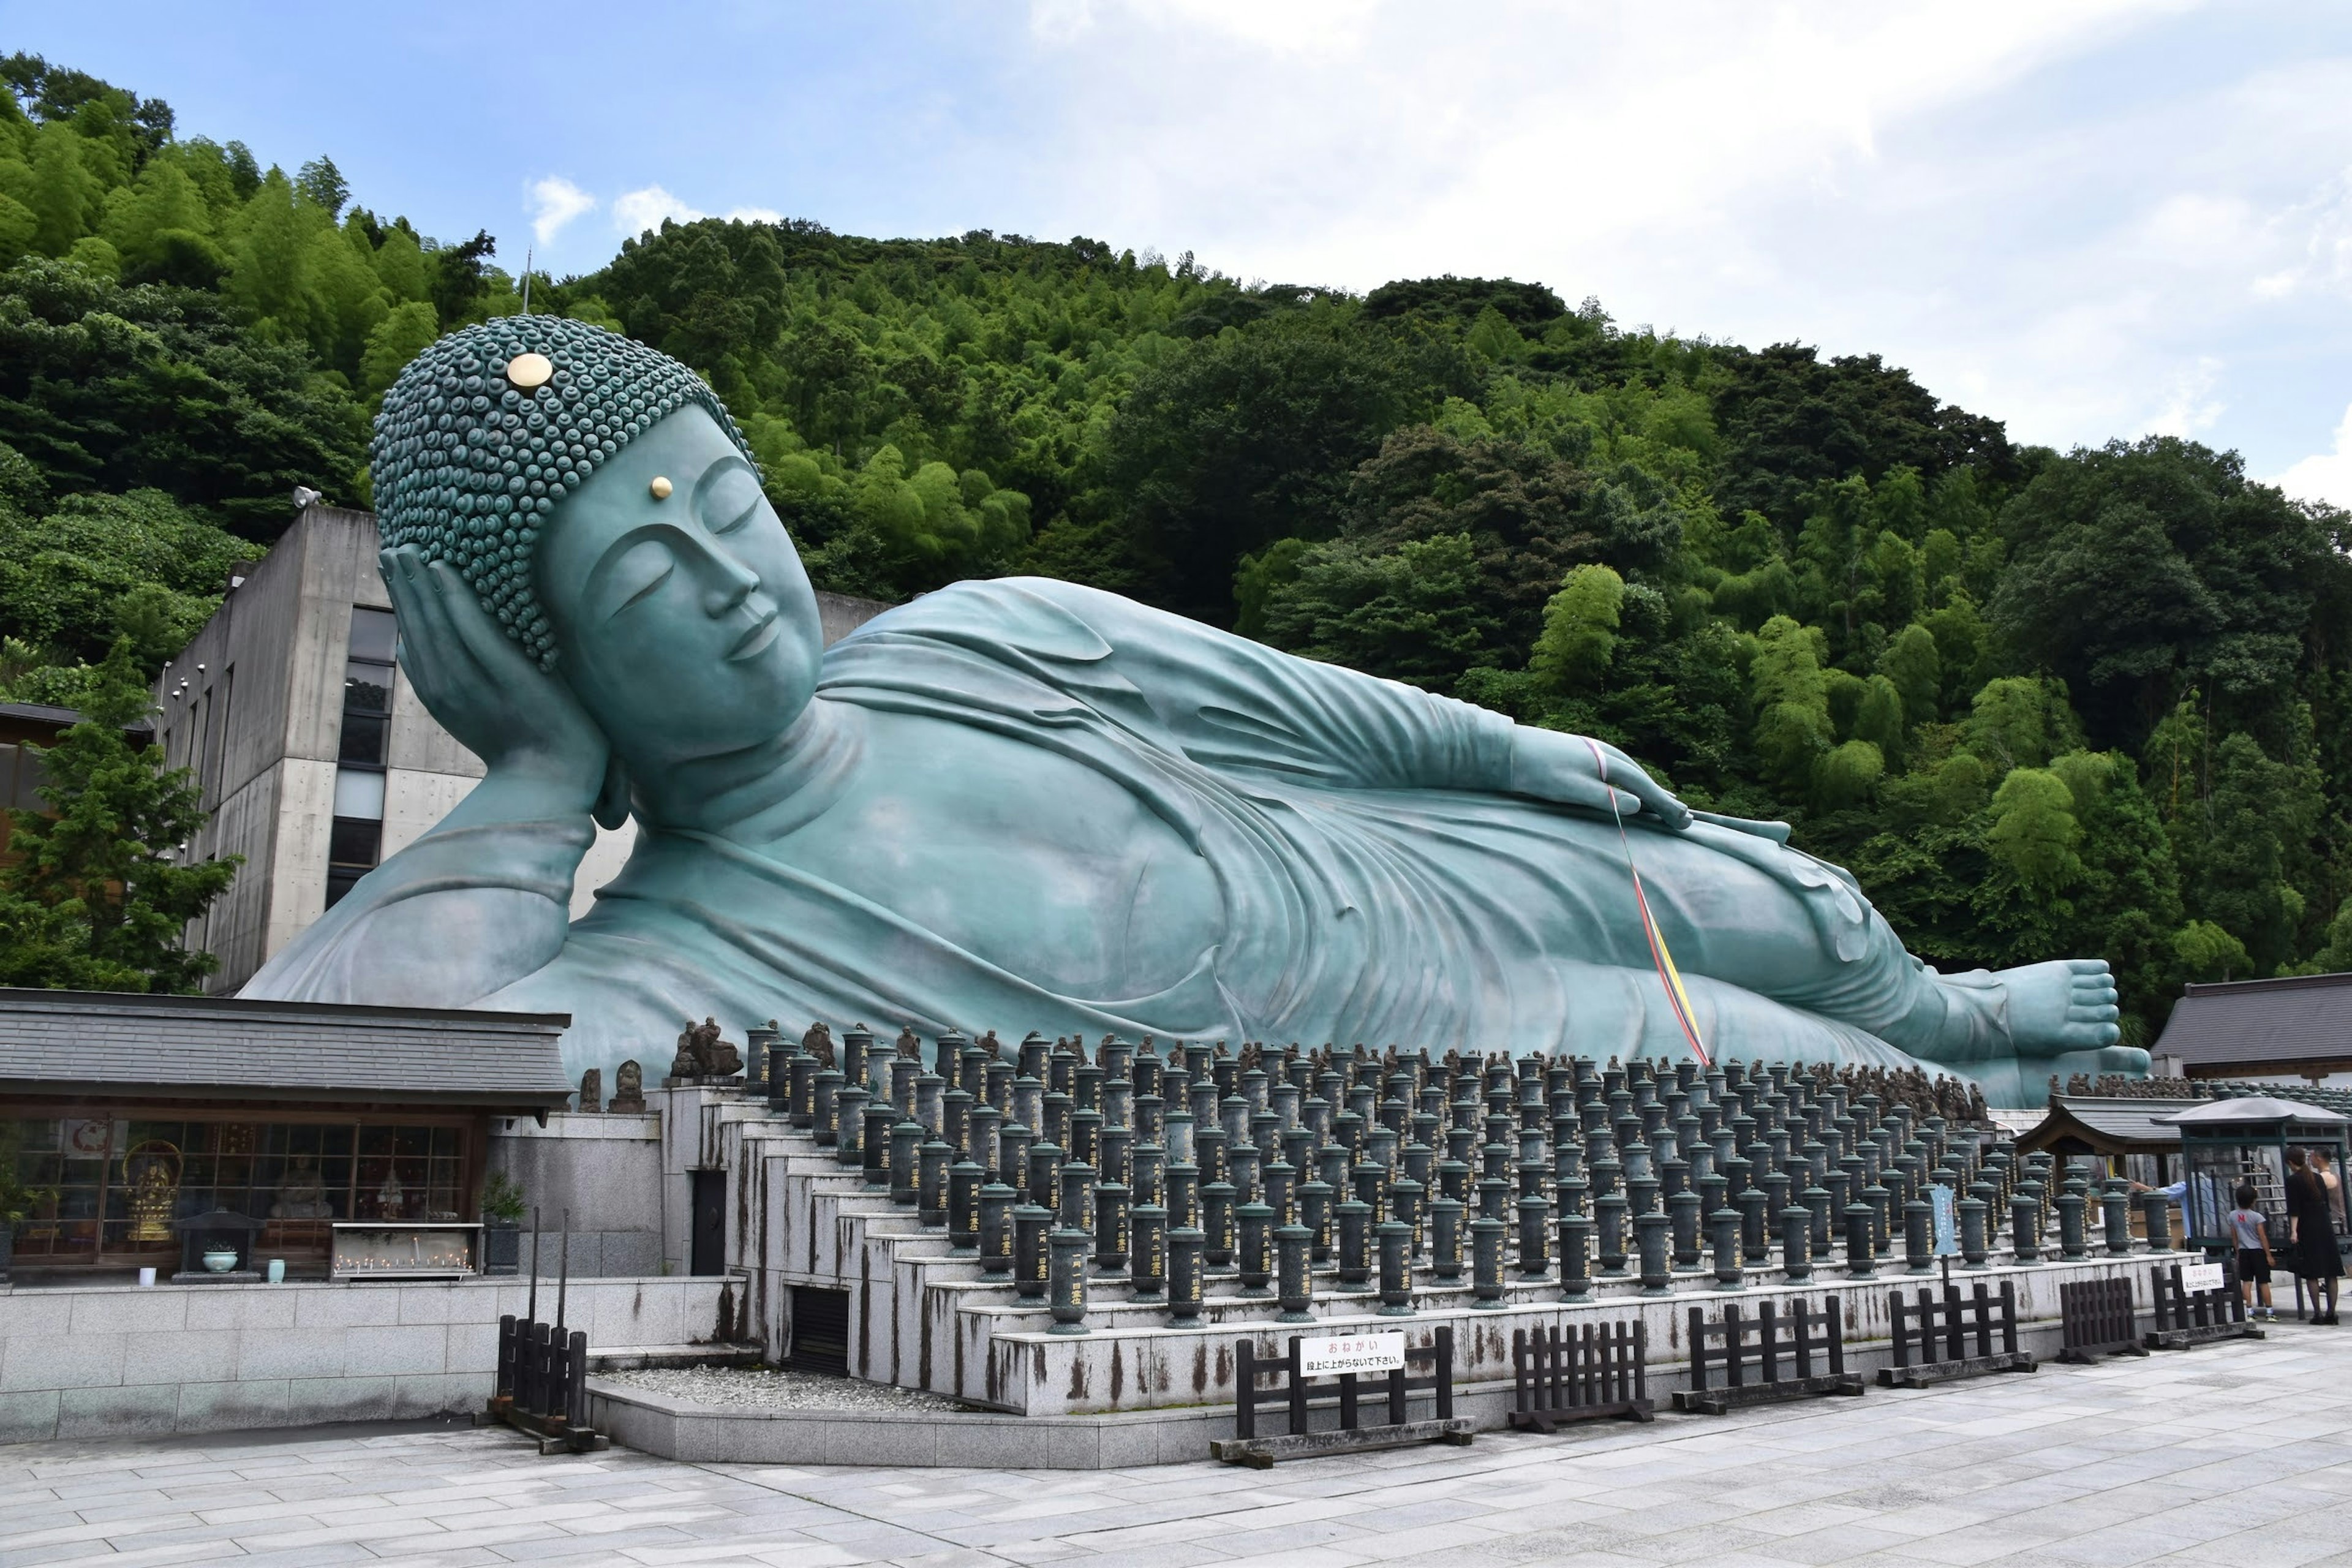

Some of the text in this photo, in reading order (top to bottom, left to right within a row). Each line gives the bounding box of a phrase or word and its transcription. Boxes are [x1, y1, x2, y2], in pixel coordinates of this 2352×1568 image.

[1329, 1340, 1378, 1354] おねがい
[1307, 1355, 1400, 1371] 段上に上がらないで下さい。
